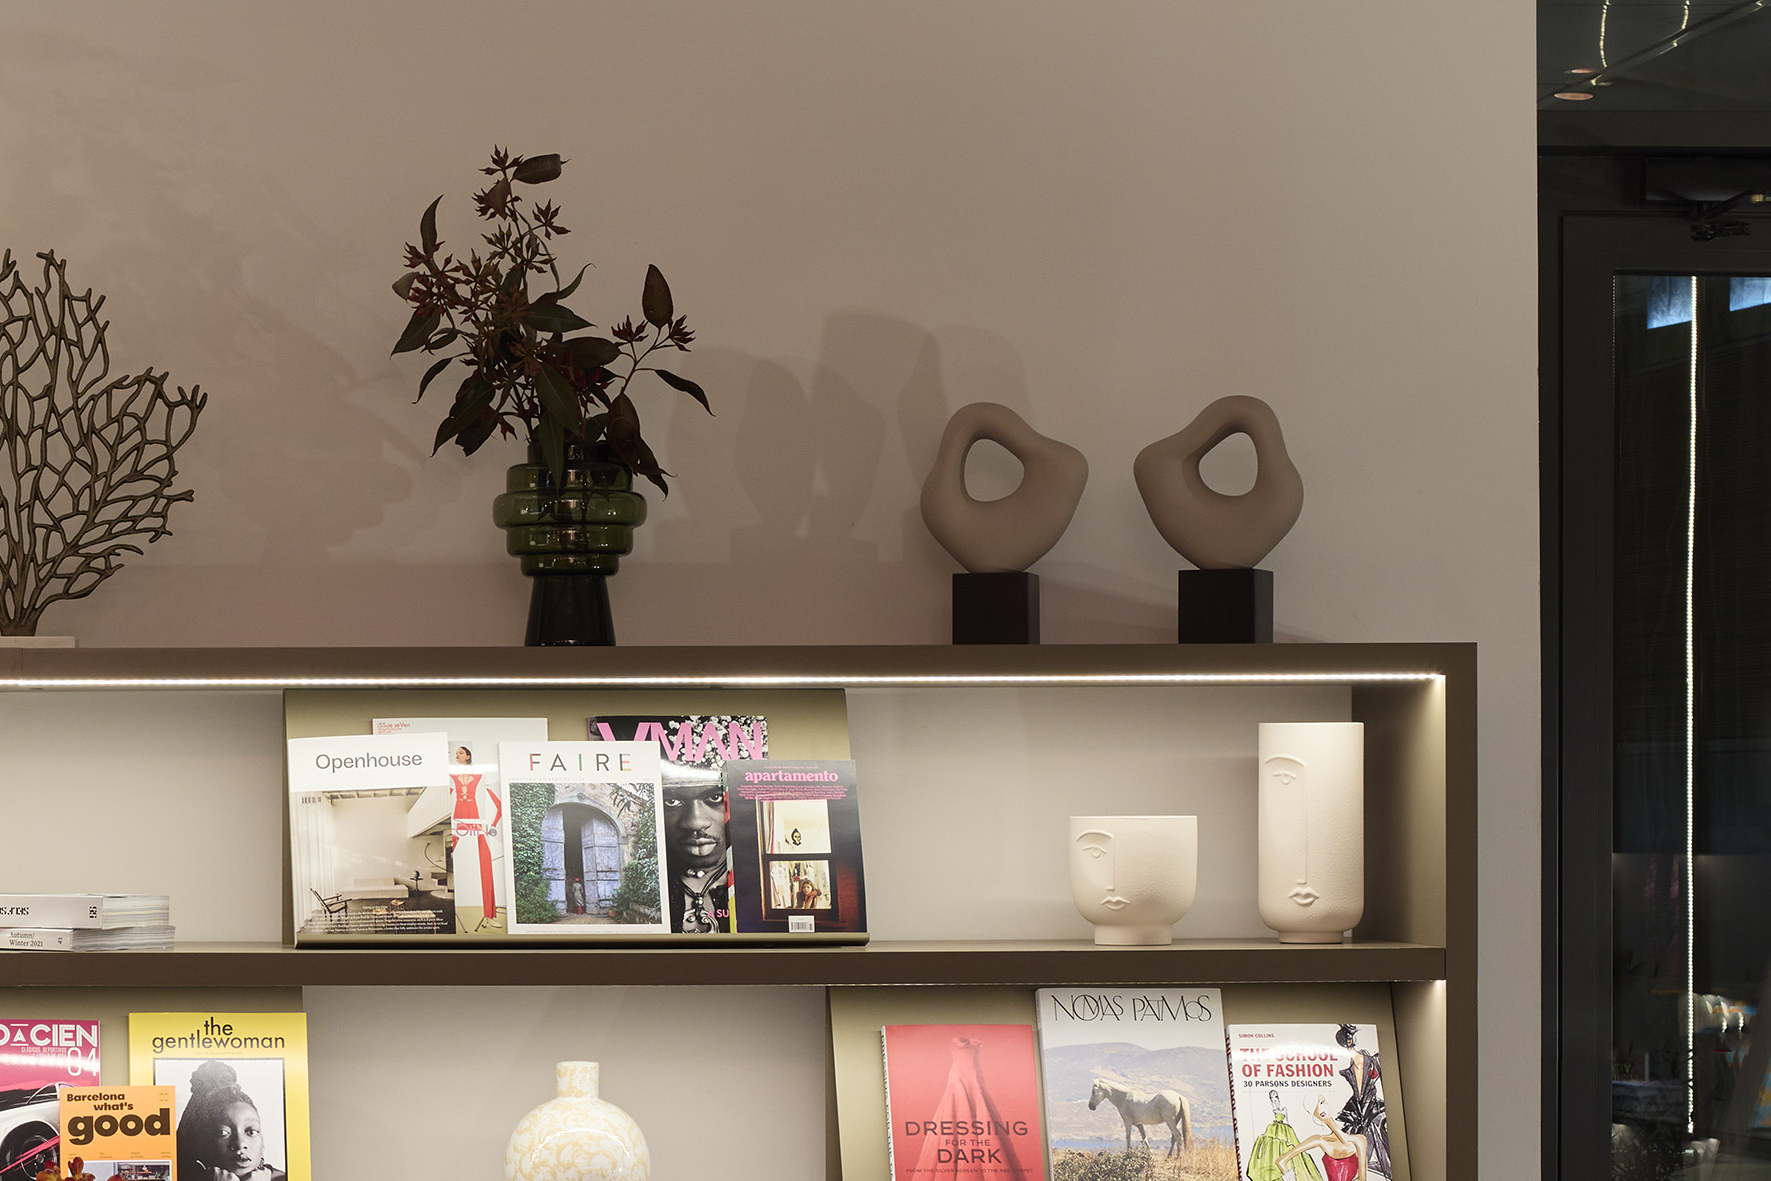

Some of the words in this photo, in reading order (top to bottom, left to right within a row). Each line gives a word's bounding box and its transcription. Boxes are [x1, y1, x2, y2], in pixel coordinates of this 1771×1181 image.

[315, 753, 423, 773] Openhouse
[529, 753, 632, 771] FAIRE
[745, 770, 839, 784] apartamento
[9, 939, 29, 947] Winter
[1051, 994, 1125, 1022] NOMAS
[204, 1016, 233, 1036] the
[13, 1028, 26, 1042] A
[30, 1024, 98, 1047] CIEN
[152, 1029, 285, 1054] gentlewoman
[1242, 1064, 1262, 1077] OF
[1266, 1064, 1334, 1077] FASHION
[67, 1093, 125, 1102] Barcelona
[94, 1102, 134, 1111] what's
[68, 1108, 171, 1145] good
[905, 1121, 1028, 1136] DRESSING
[937, 1149, 1002, 1164] DARK
